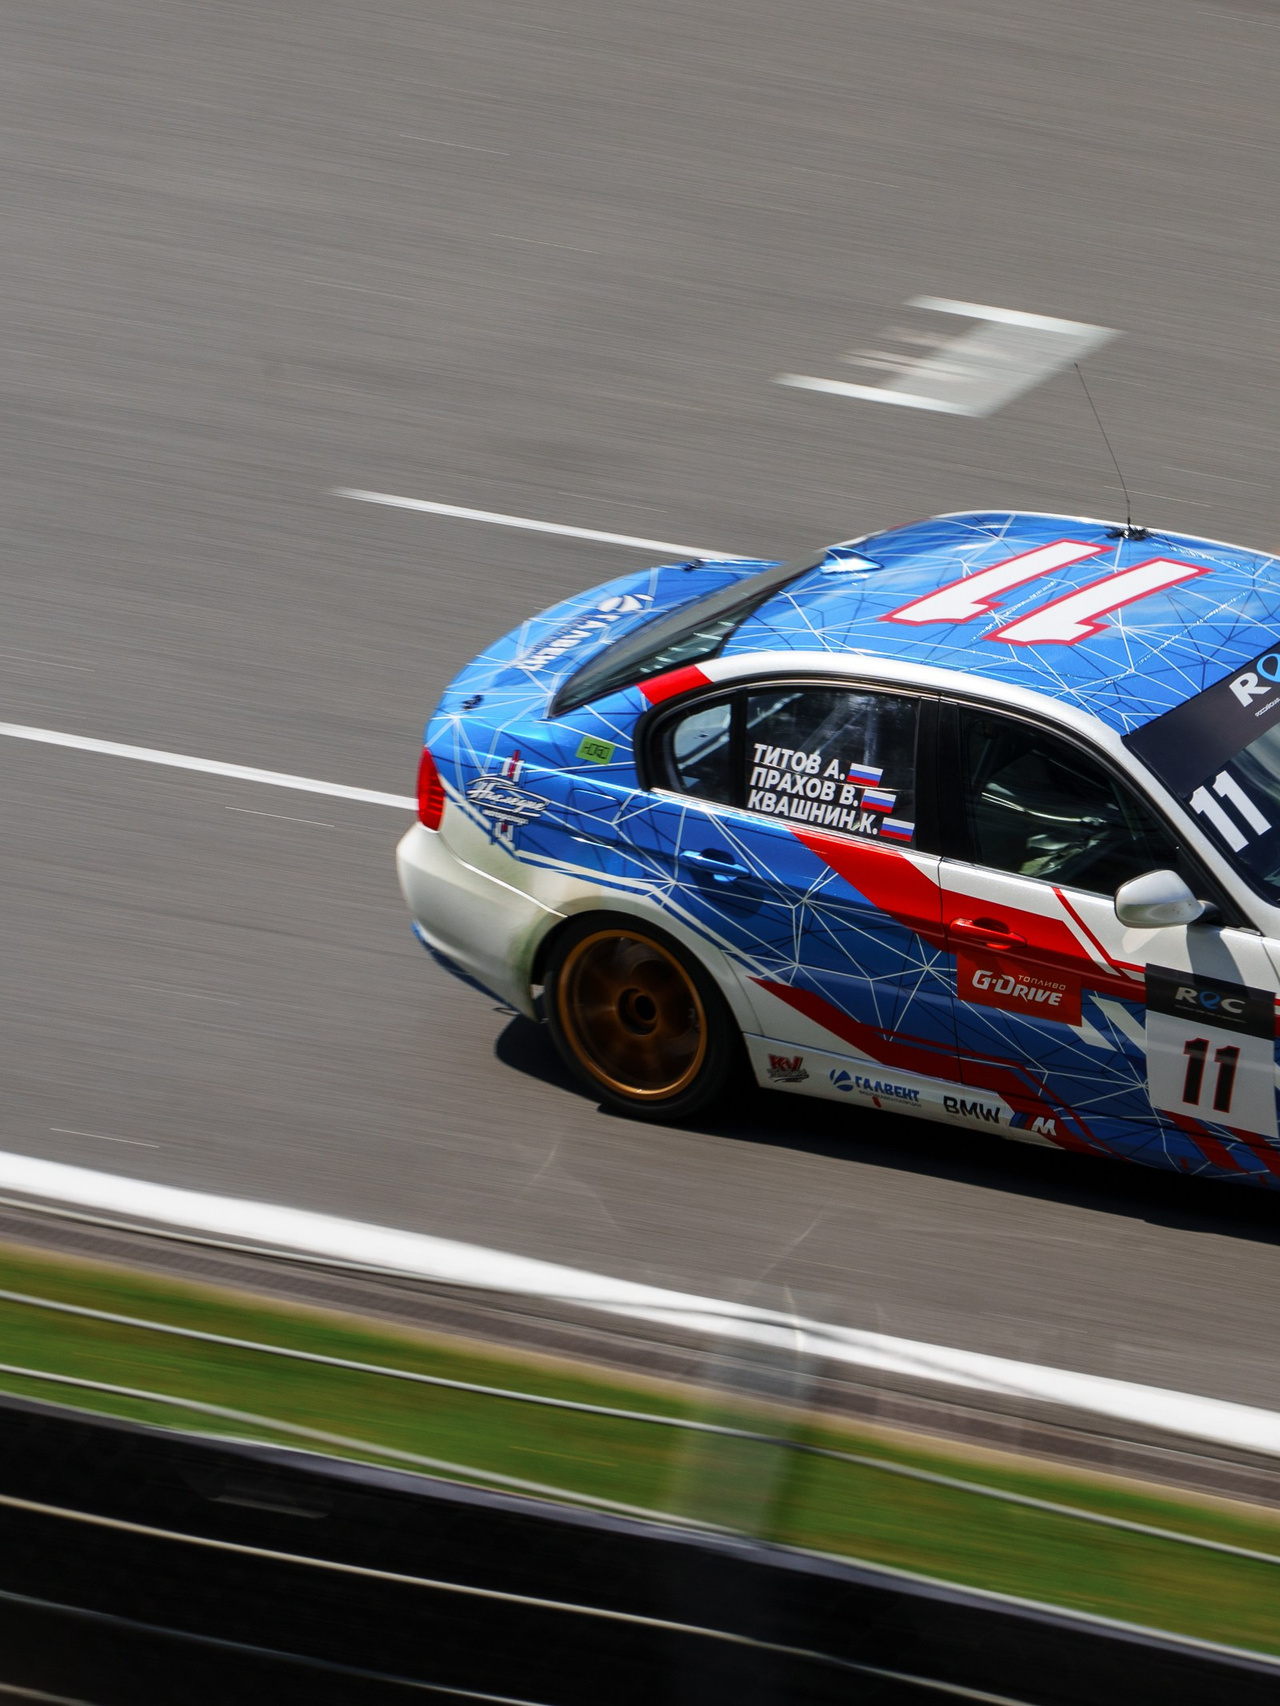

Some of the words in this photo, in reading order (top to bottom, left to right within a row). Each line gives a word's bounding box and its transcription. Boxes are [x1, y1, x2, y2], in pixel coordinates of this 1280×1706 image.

[877, 538, 1215, 647] 11
[753, 743, 821, 774] ТИТОВ
[824, 759, 845, 780] А.
[750, 766, 836, 801] ПРАХОВ
[839, 784, 859, 807] В.
[747, 789, 855, 831] КВАШНИН
[859, 814, 878, 835] К.
[1189, 770, 1272, 853] 11
[1018, 974, 1066, 991] ТОПЛИВО
[768, 1053, 804, 1071] KV
[1182, 1037, 1241, 1114] 11
[855, 1076, 920, 1102] ГАЛВЕНТ
[943, 1095, 1000, 1124] BMW
[1031, 1116, 1057, 1136] M
